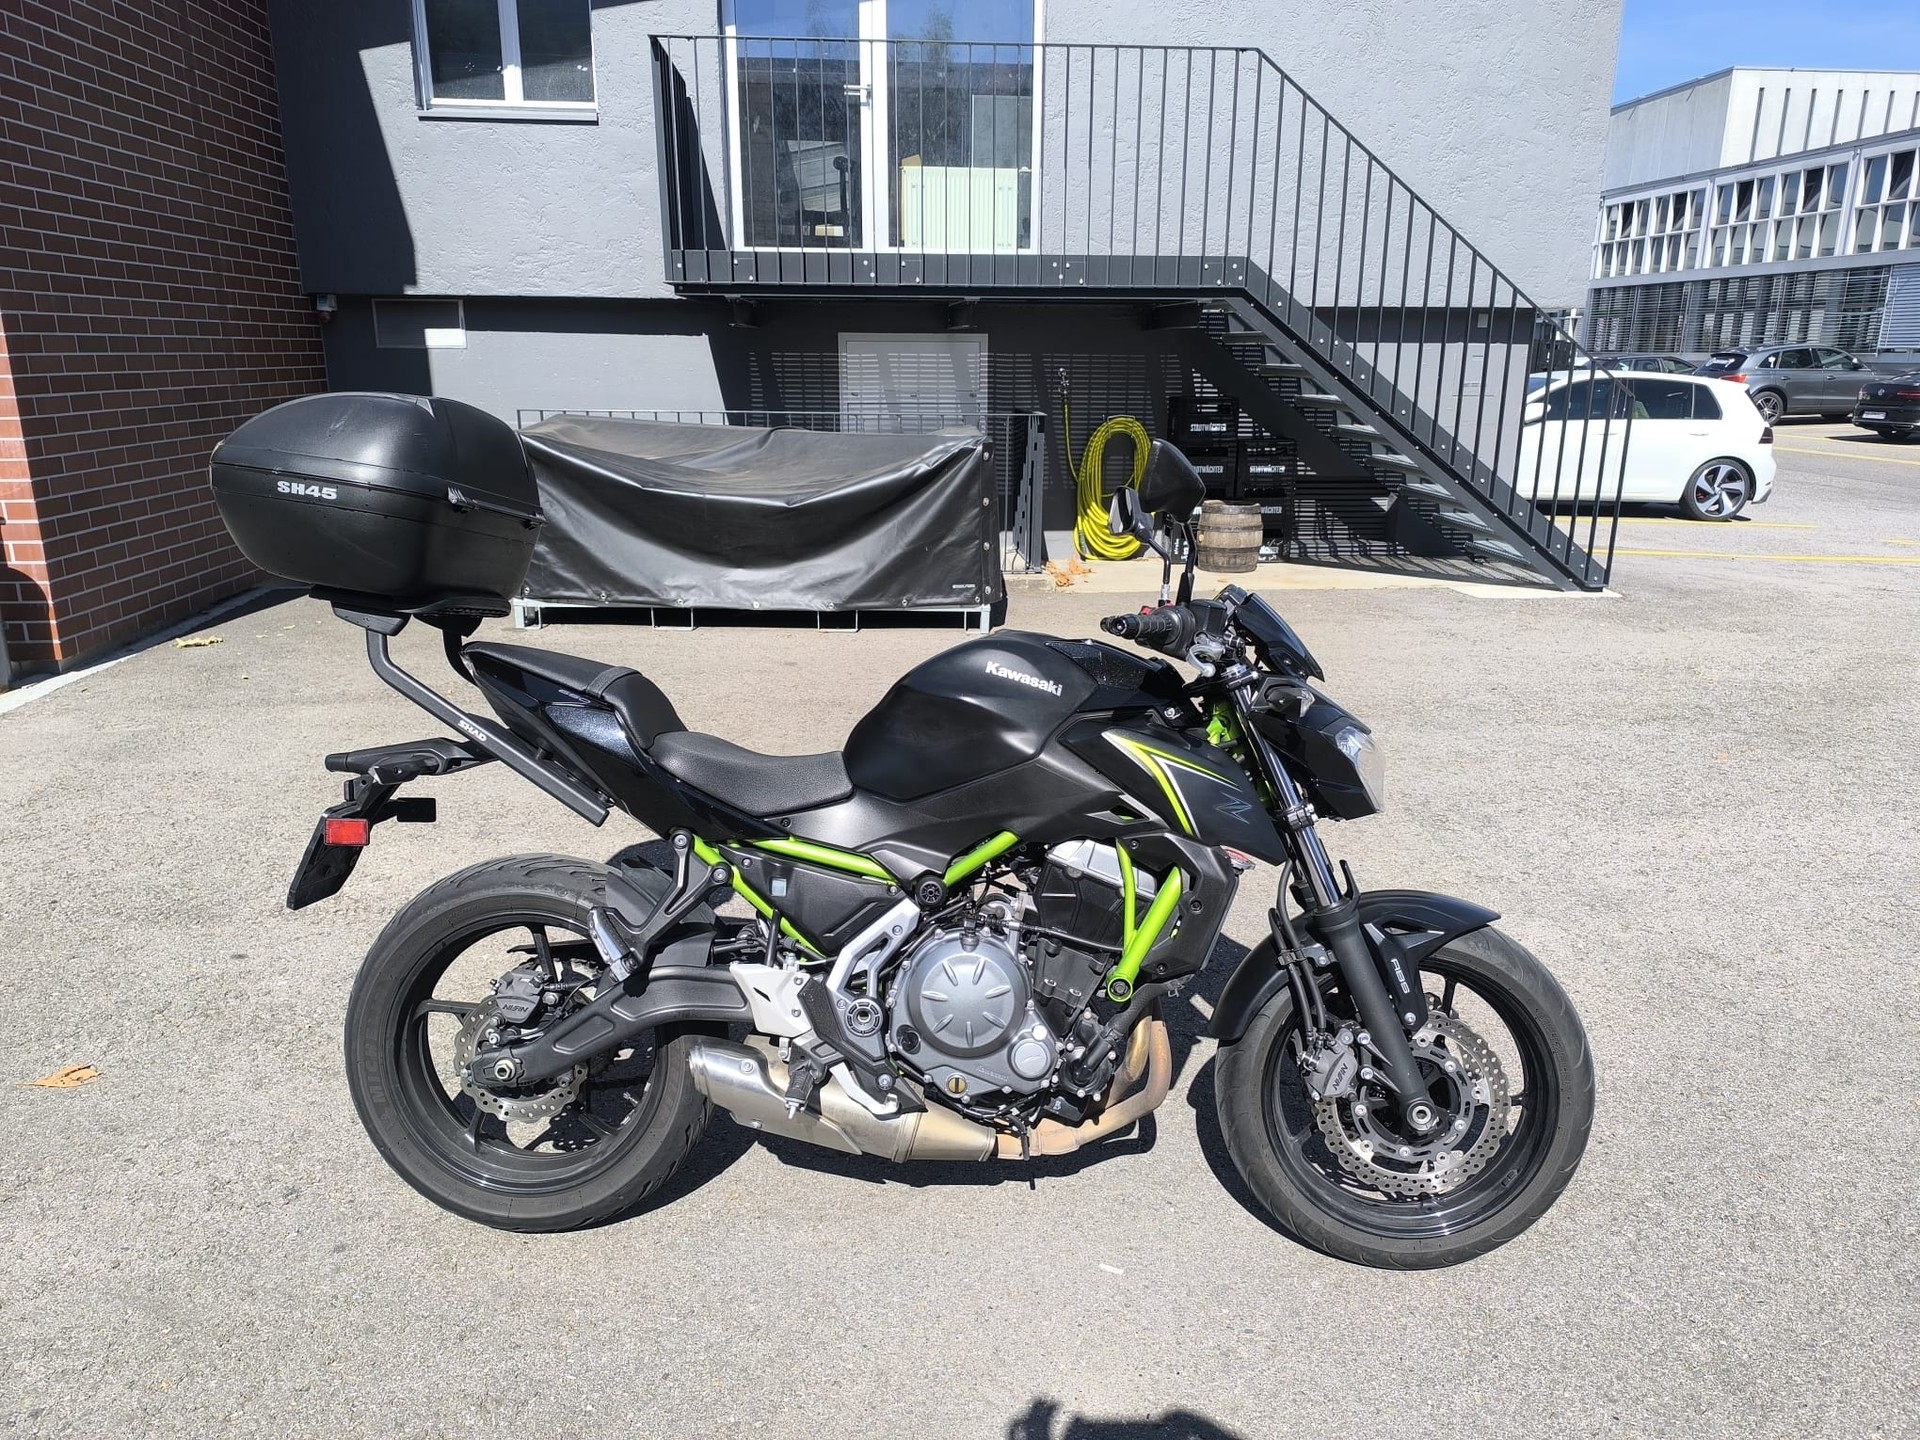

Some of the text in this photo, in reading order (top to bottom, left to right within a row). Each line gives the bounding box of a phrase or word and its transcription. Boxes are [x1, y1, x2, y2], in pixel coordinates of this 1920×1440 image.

[276, 480, 338, 501] SH45
[985, 660, 1064, 698] Kawasaki
[457, 719, 487, 742] SHAD
[1391, 958, 1410, 994] ABS
